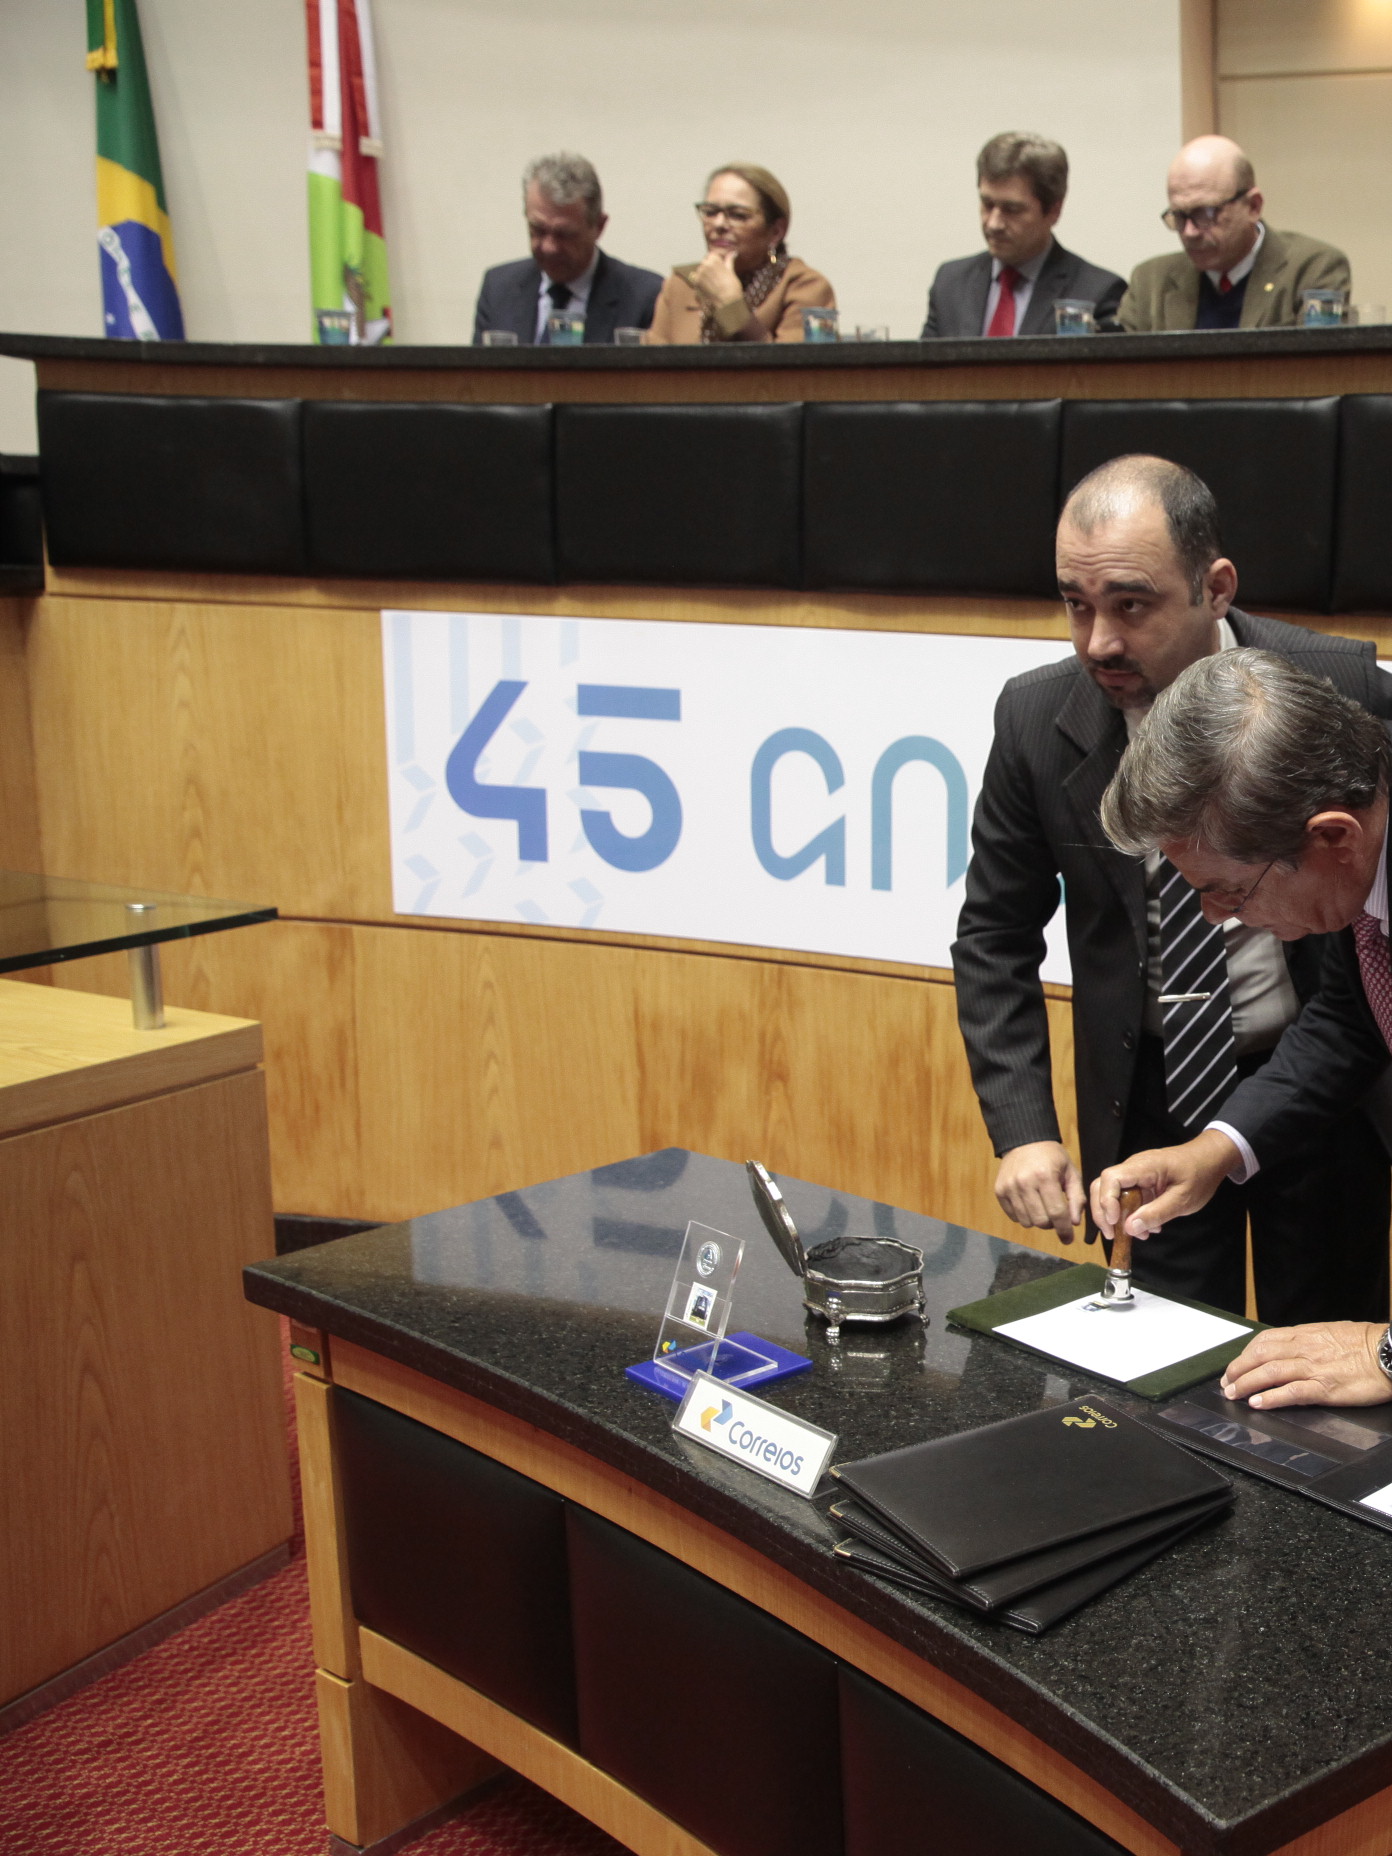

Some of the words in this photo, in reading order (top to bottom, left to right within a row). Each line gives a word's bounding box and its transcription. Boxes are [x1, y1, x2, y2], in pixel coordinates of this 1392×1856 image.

[446, 680, 683, 873] 45
[751, 726, 969, 892] an
[728, 1420, 805, 1476] Correios
